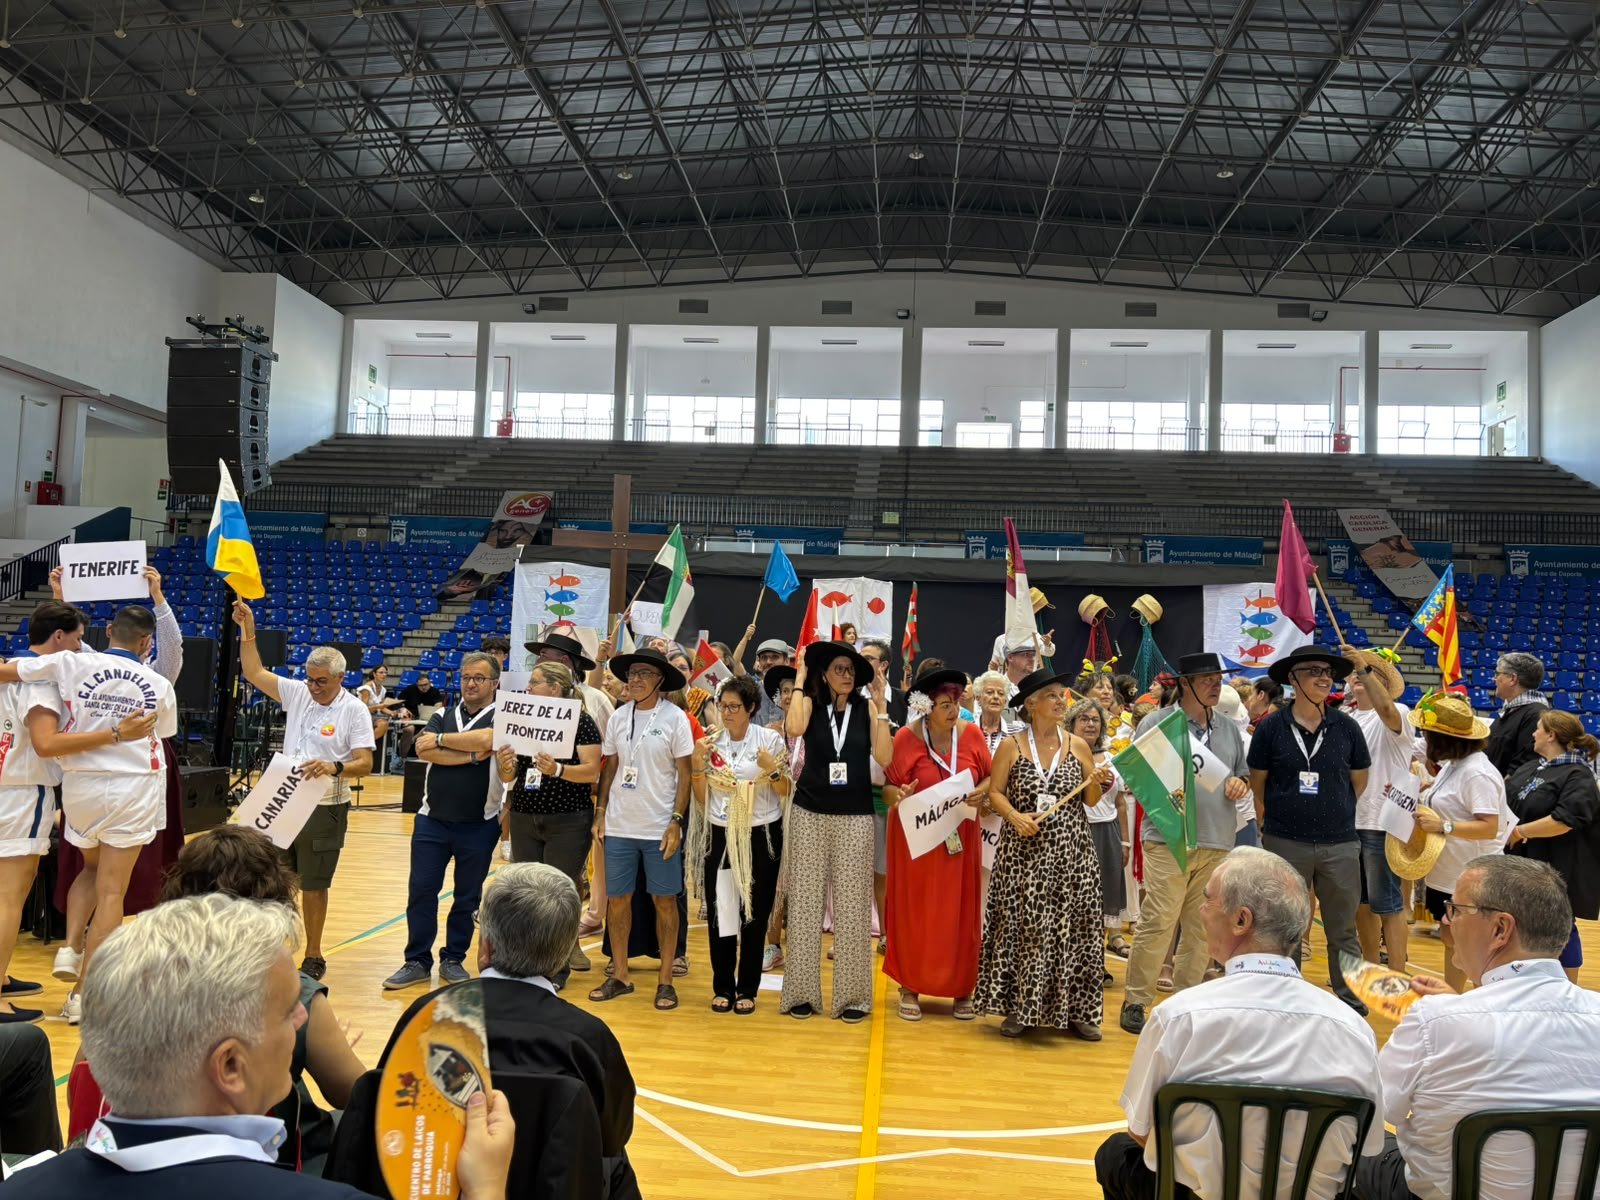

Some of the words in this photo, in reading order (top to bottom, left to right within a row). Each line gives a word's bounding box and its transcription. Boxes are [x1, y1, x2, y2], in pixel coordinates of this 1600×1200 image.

[410, 528, 456, 537] Ayuntamiento
[468, 529, 484, 537] Mála
[817, 540, 839, 548] Málag
[1168, 549, 1221, 558] Ayuntamiento
[1223, 550, 1232, 558] de
[1234, 551, 1262, 559] Málaga
[69, 560, 139, 578] TENERIFE
[1534, 560, 1589, 569] Ayuntamiento
[98, 694, 135, 706] AYUNTAMIENTO
[114, 703, 120, 711] DE
[121, 705, 128, 713] LA
[501, 701, 534, 716] JEREZ
[537, 705, 554, 718] DE
[556, 707, 572, 720] LA
[505, 723, 564, 742] FRONTERA
[255, 765, 304, 830] CANARIAS
[915, 793, 968, 829] MÁLAGA
[414, 1115, 425, 1146] LAICOS
[412, 1147, 422, 1159] DE
[423, 1131, 435, 1181] PARROQUIA
[409, 1161, 421, 1200] CUENTRO
[422, 1183, 431, 1195] DE
